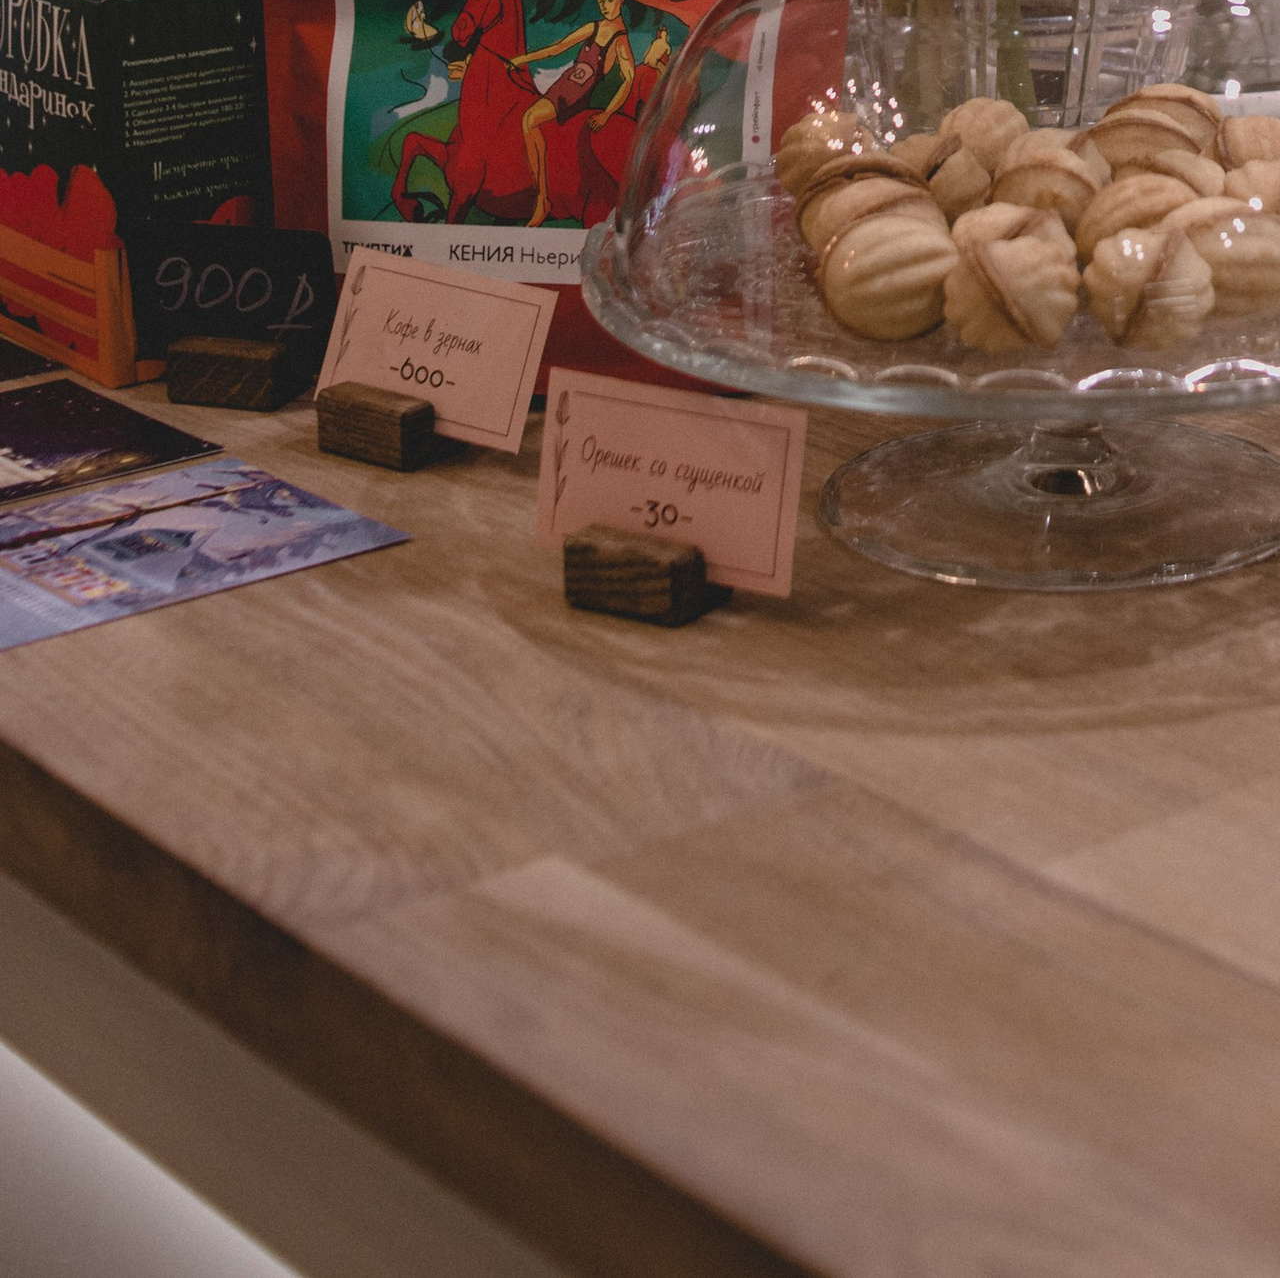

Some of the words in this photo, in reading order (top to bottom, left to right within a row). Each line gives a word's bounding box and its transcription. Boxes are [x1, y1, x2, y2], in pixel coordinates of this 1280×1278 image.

[449, 243, 513, 262] КЕНИЯ
[154, 256, 272, 313] 900
[383, 308, 420, 345] Кофе
[424, 318, 435, 342] в
[433, 330, 483, 357] зернах
[581, 434, 642, 473] Орешек
[650, 458, 667, 475] со
[674, 462, 766, 494] сгущенкой
